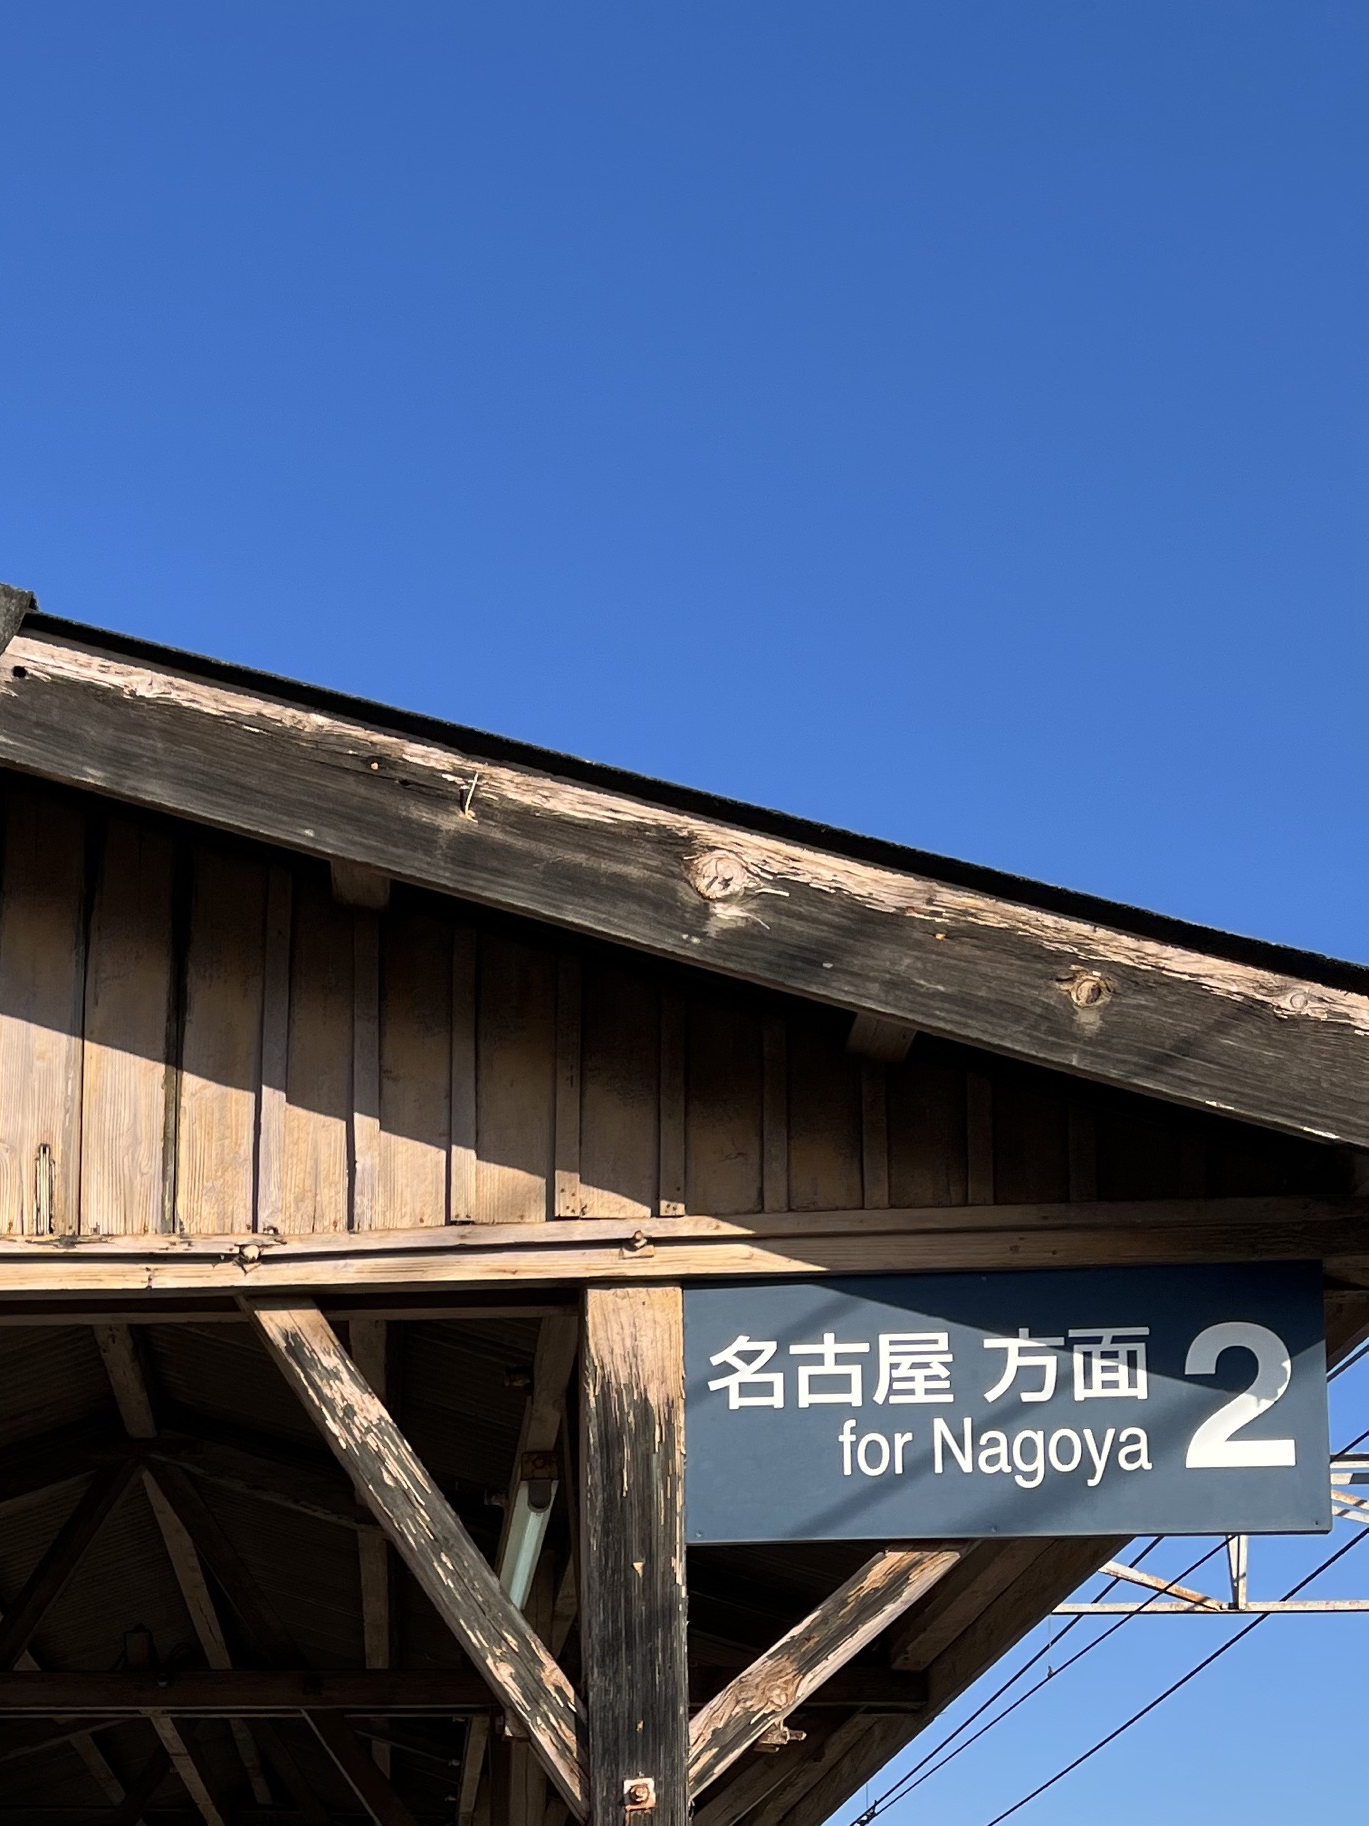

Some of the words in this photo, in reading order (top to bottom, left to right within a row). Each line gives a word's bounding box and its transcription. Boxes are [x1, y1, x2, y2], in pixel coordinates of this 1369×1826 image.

[708, 1332, 954, 1409] 名古屋
[983, 1326, 1151, 1404] 方面
[1183, 1321, 1297, 1470] 2
[838, 1419, 914, 1477] for
[933, 1417, 1153, 1489] Nagoya
